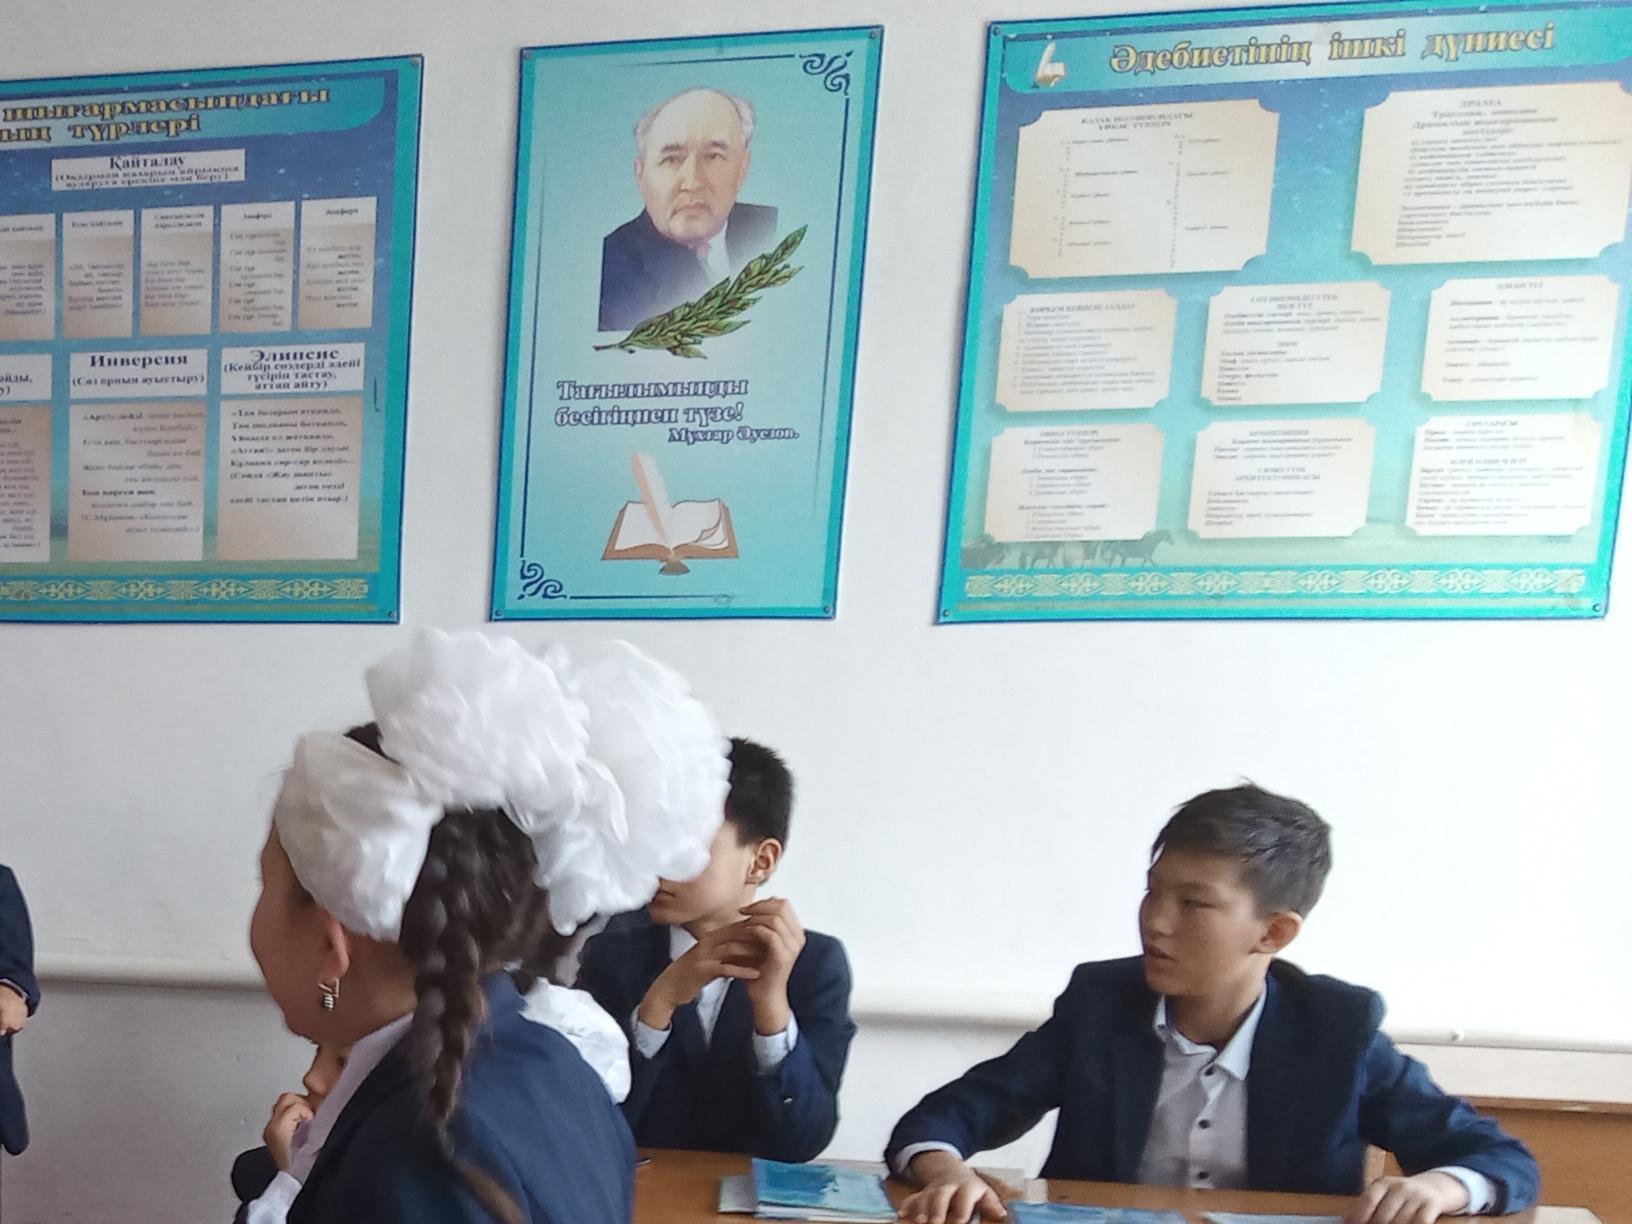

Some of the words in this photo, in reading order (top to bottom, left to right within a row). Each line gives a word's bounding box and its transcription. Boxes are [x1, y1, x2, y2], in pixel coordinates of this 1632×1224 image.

[1327, 28, 1407, 61] ішкі
[1421, 22, 1557, 62] дүниесі
[2, 89, 331, 122] шығармасындағы
[67, 114, 201, 142] түрлері
[109, 154, 184, 170] Қайталау
[89, 354, 188, 368] Инверсия
[249, 349, 340, 363] Элипсис
[556, 379, 750, 401] Тағылымыңды
[682, 402, 745, 427] түзе!
